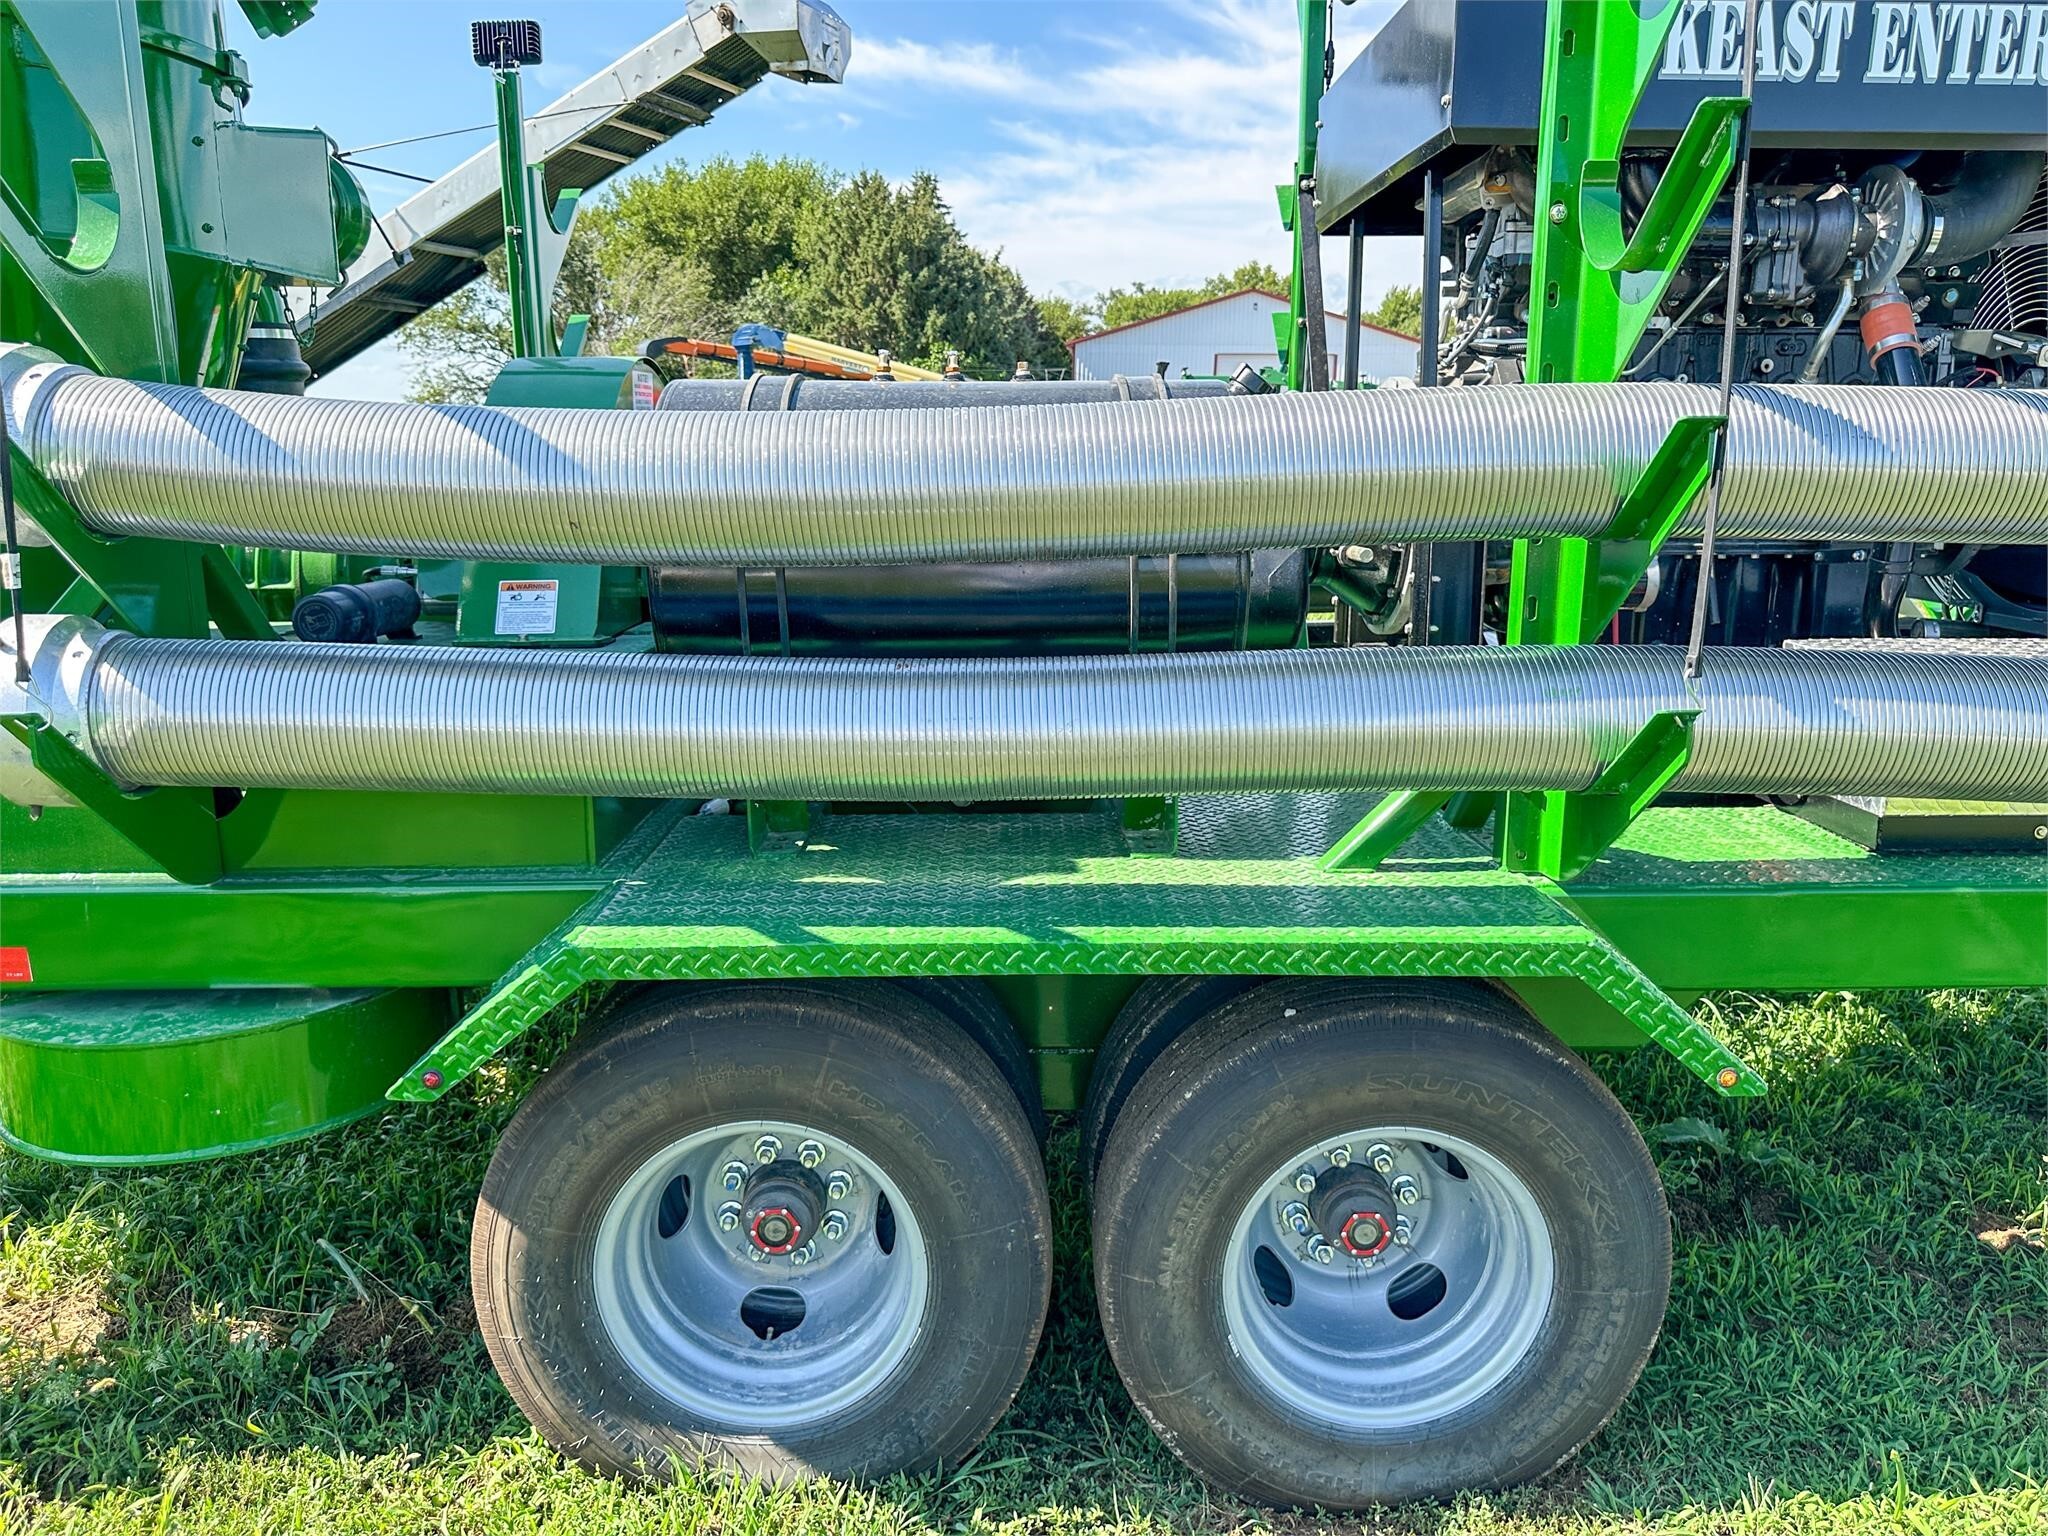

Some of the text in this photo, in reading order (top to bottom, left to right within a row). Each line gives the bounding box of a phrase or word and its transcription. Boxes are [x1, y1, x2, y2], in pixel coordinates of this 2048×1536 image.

[1658, 0, 1853, 83] KEAST
[829, 1080, 886, 1114] HD
[1366, 1070, 1612, 1212] SUNTEK
